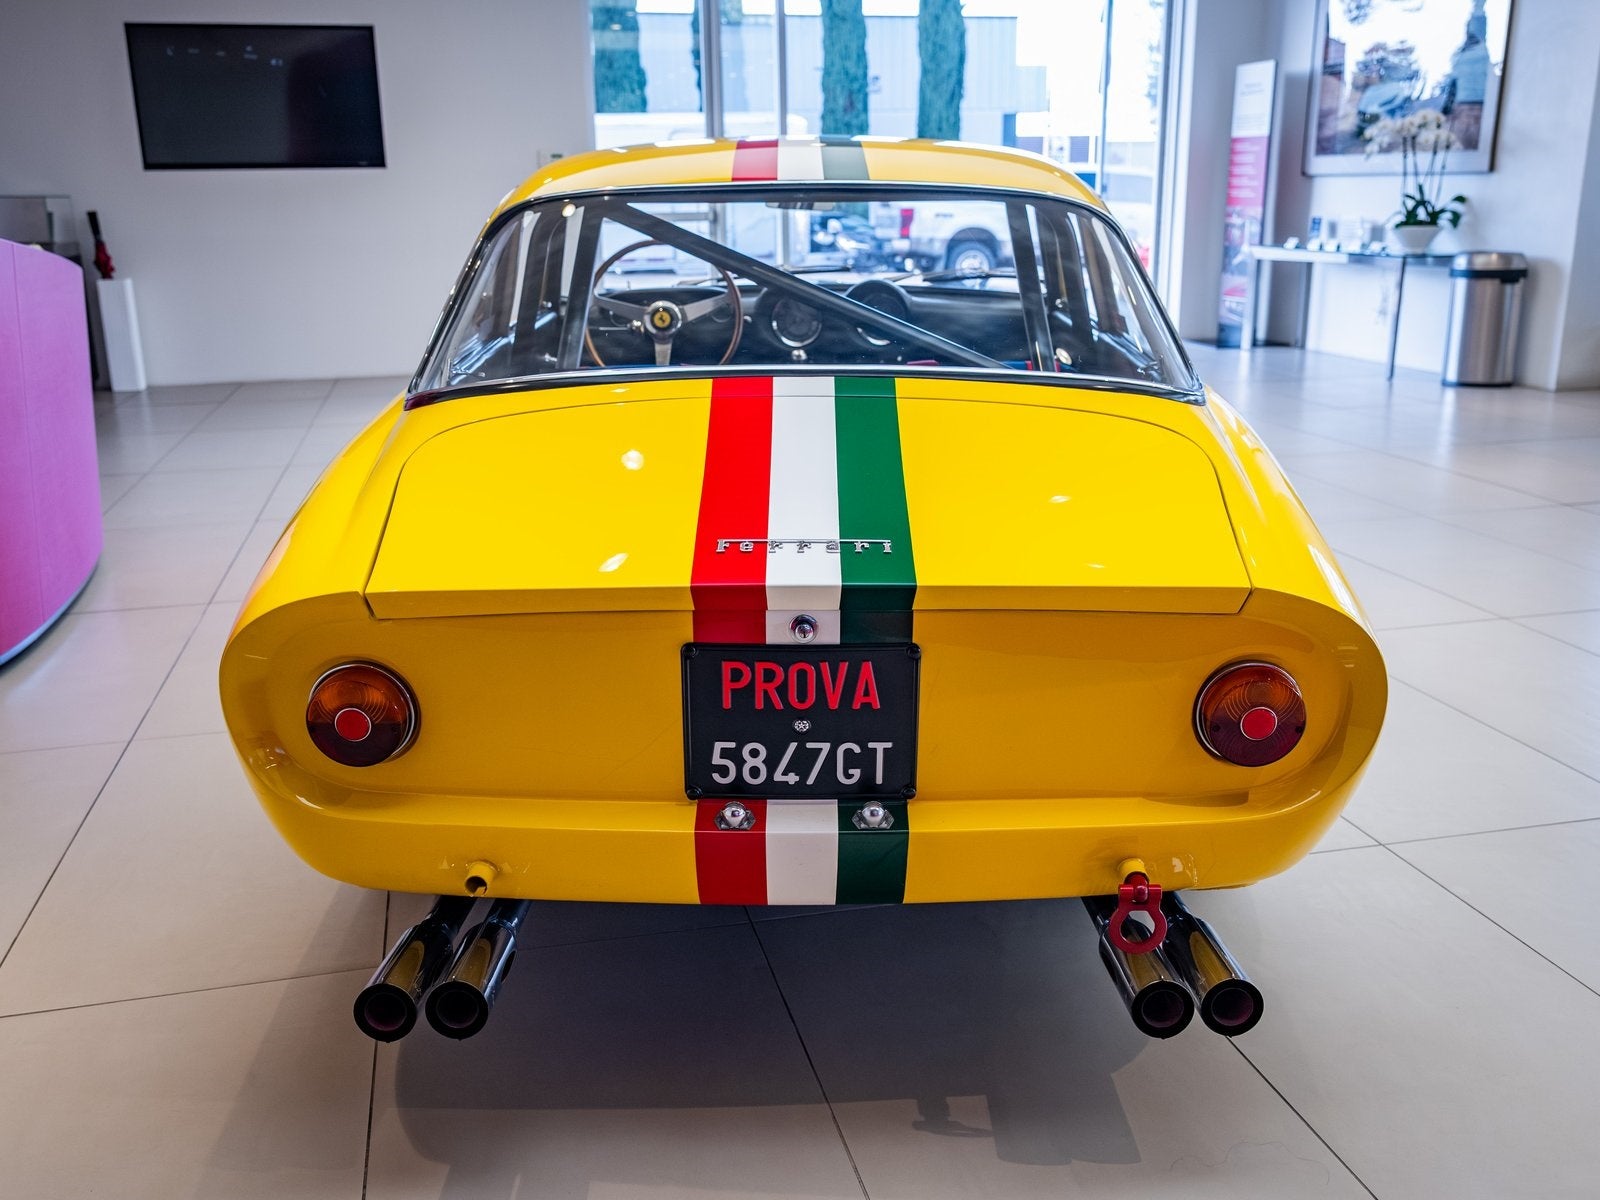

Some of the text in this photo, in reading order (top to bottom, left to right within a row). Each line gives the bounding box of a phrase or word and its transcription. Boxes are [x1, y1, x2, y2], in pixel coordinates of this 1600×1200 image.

[715, 538, 893, 554] Ferrari
[721, 660, 881, 711] PROVA
[711, 741, 893, 786] 5847GT
